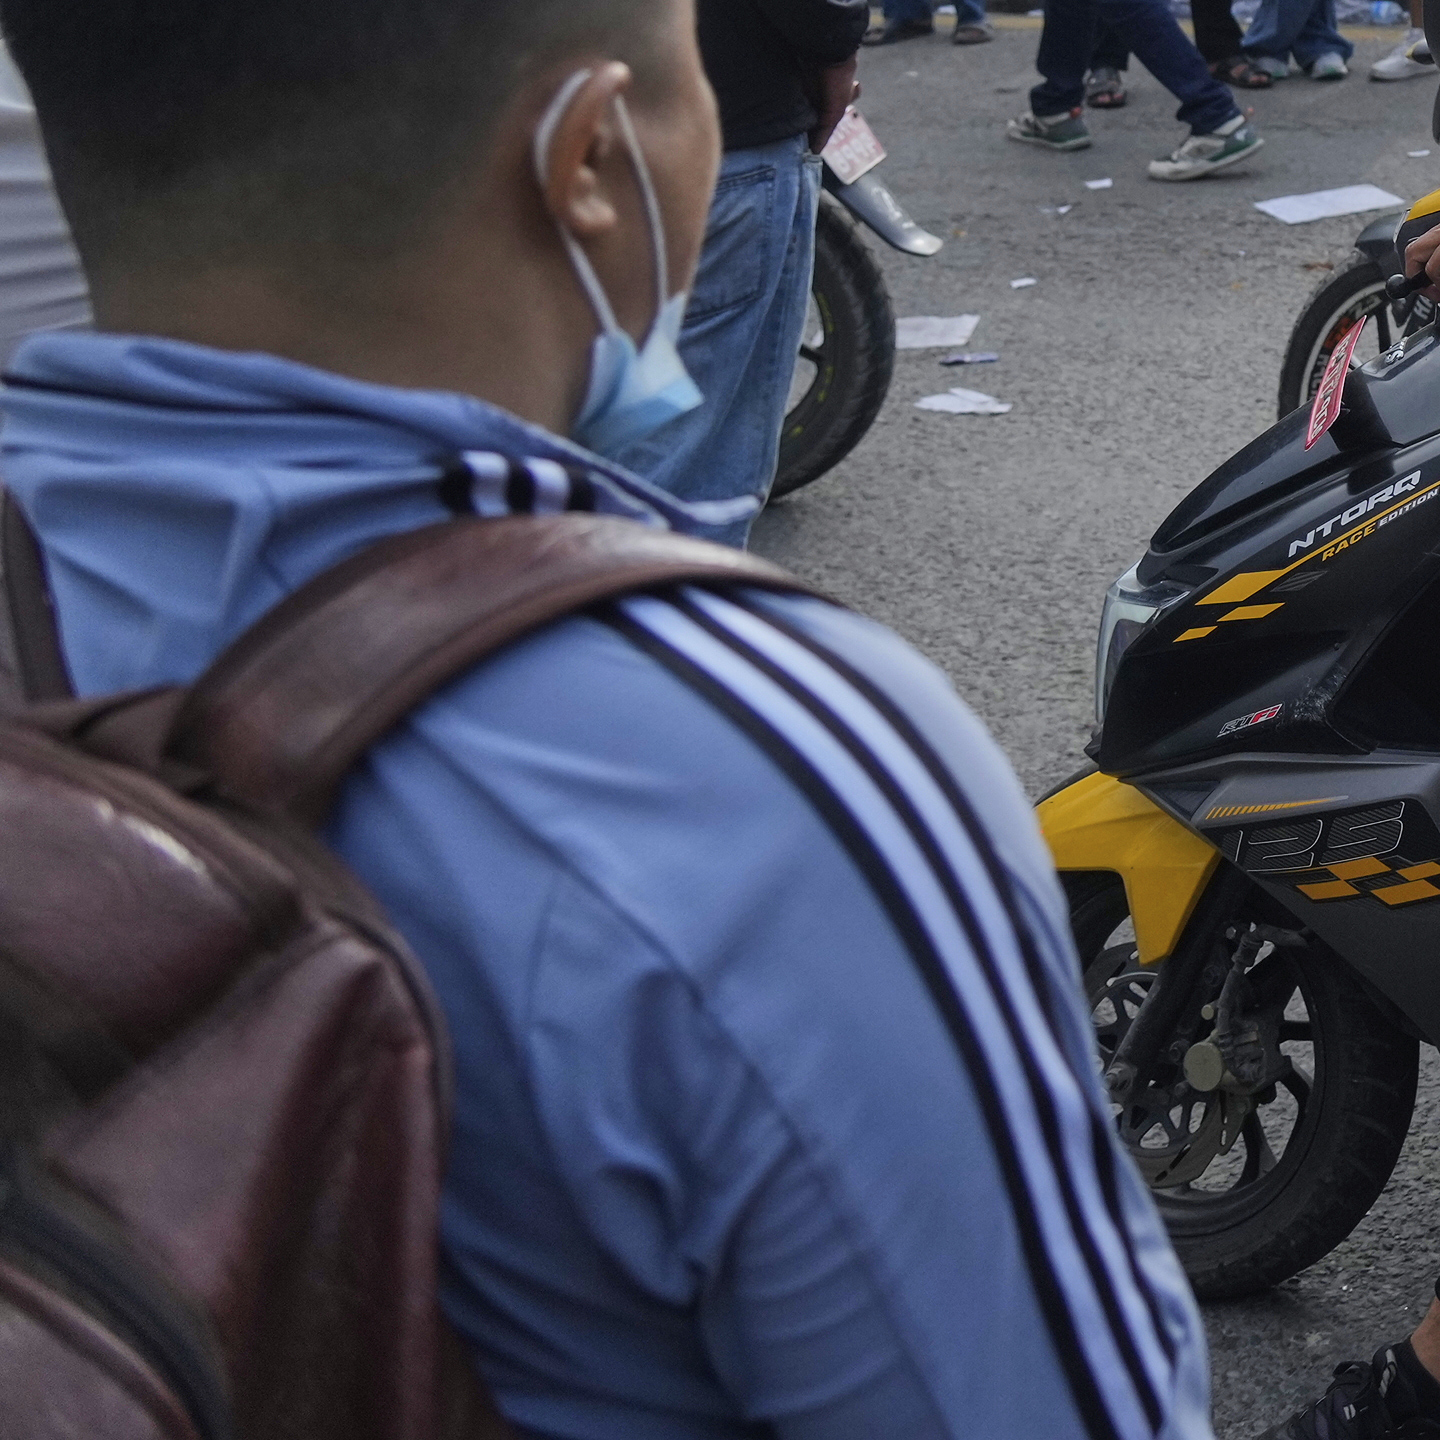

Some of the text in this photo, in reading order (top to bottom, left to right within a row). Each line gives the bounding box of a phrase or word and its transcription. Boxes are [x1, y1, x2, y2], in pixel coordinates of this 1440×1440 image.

[1288, 469, 1422, 558] NTORQ
[1321, 488, 1439, 562] RACE EDITION
